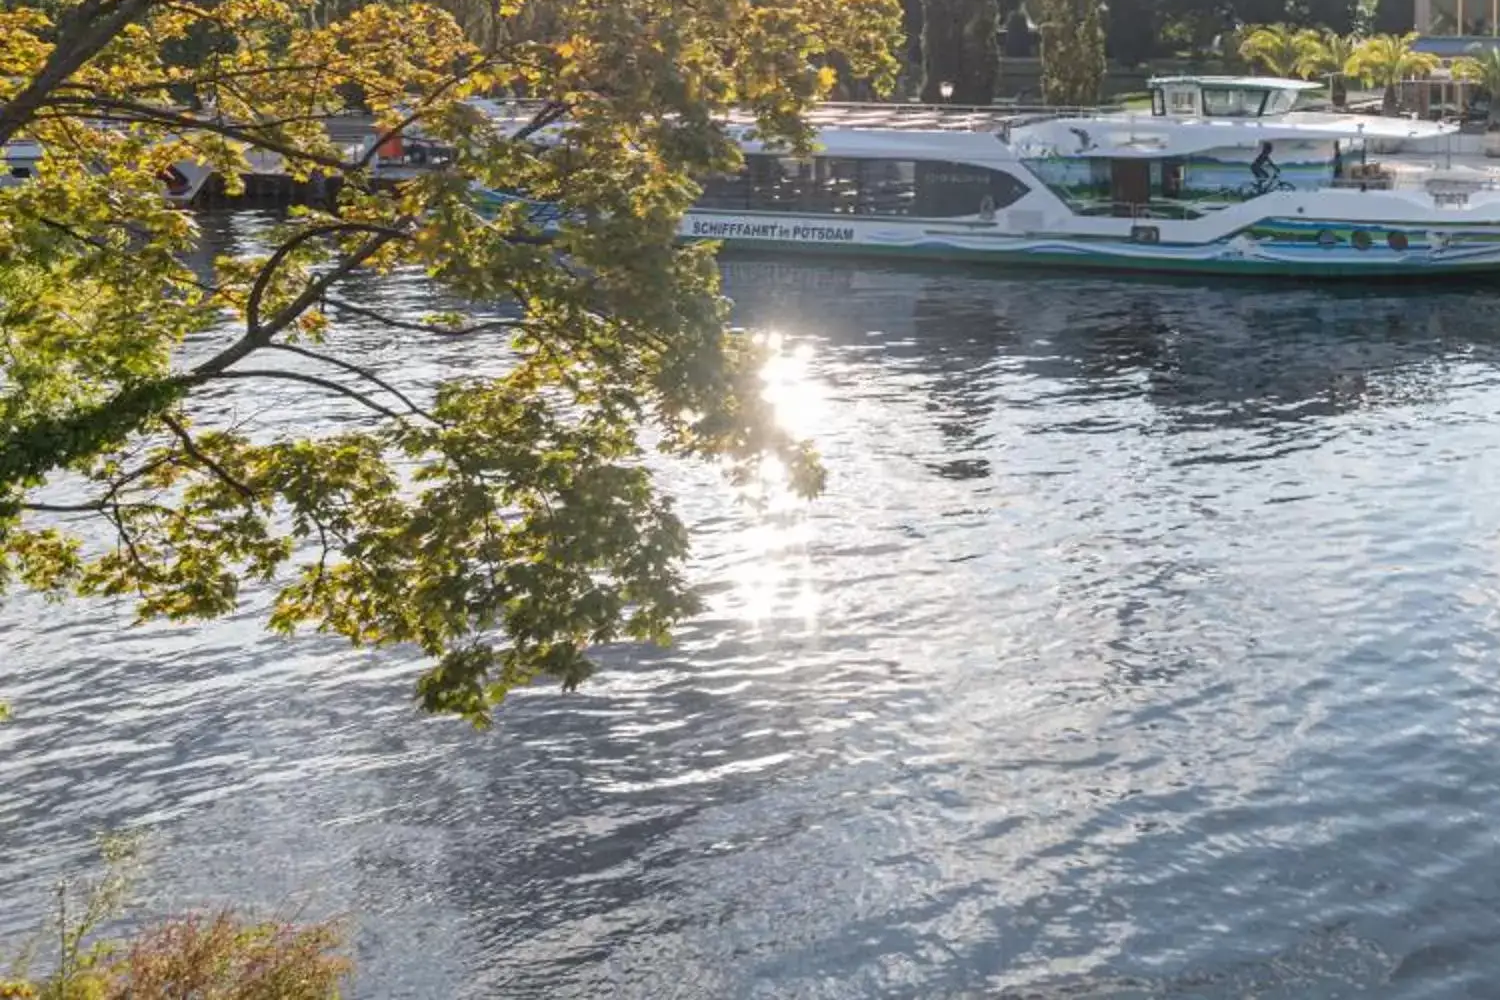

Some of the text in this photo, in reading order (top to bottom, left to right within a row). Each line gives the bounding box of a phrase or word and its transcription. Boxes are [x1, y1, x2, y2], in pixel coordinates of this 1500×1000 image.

[693, 221, 854, 240] SCHIFFFAHRT in POTSDAM
